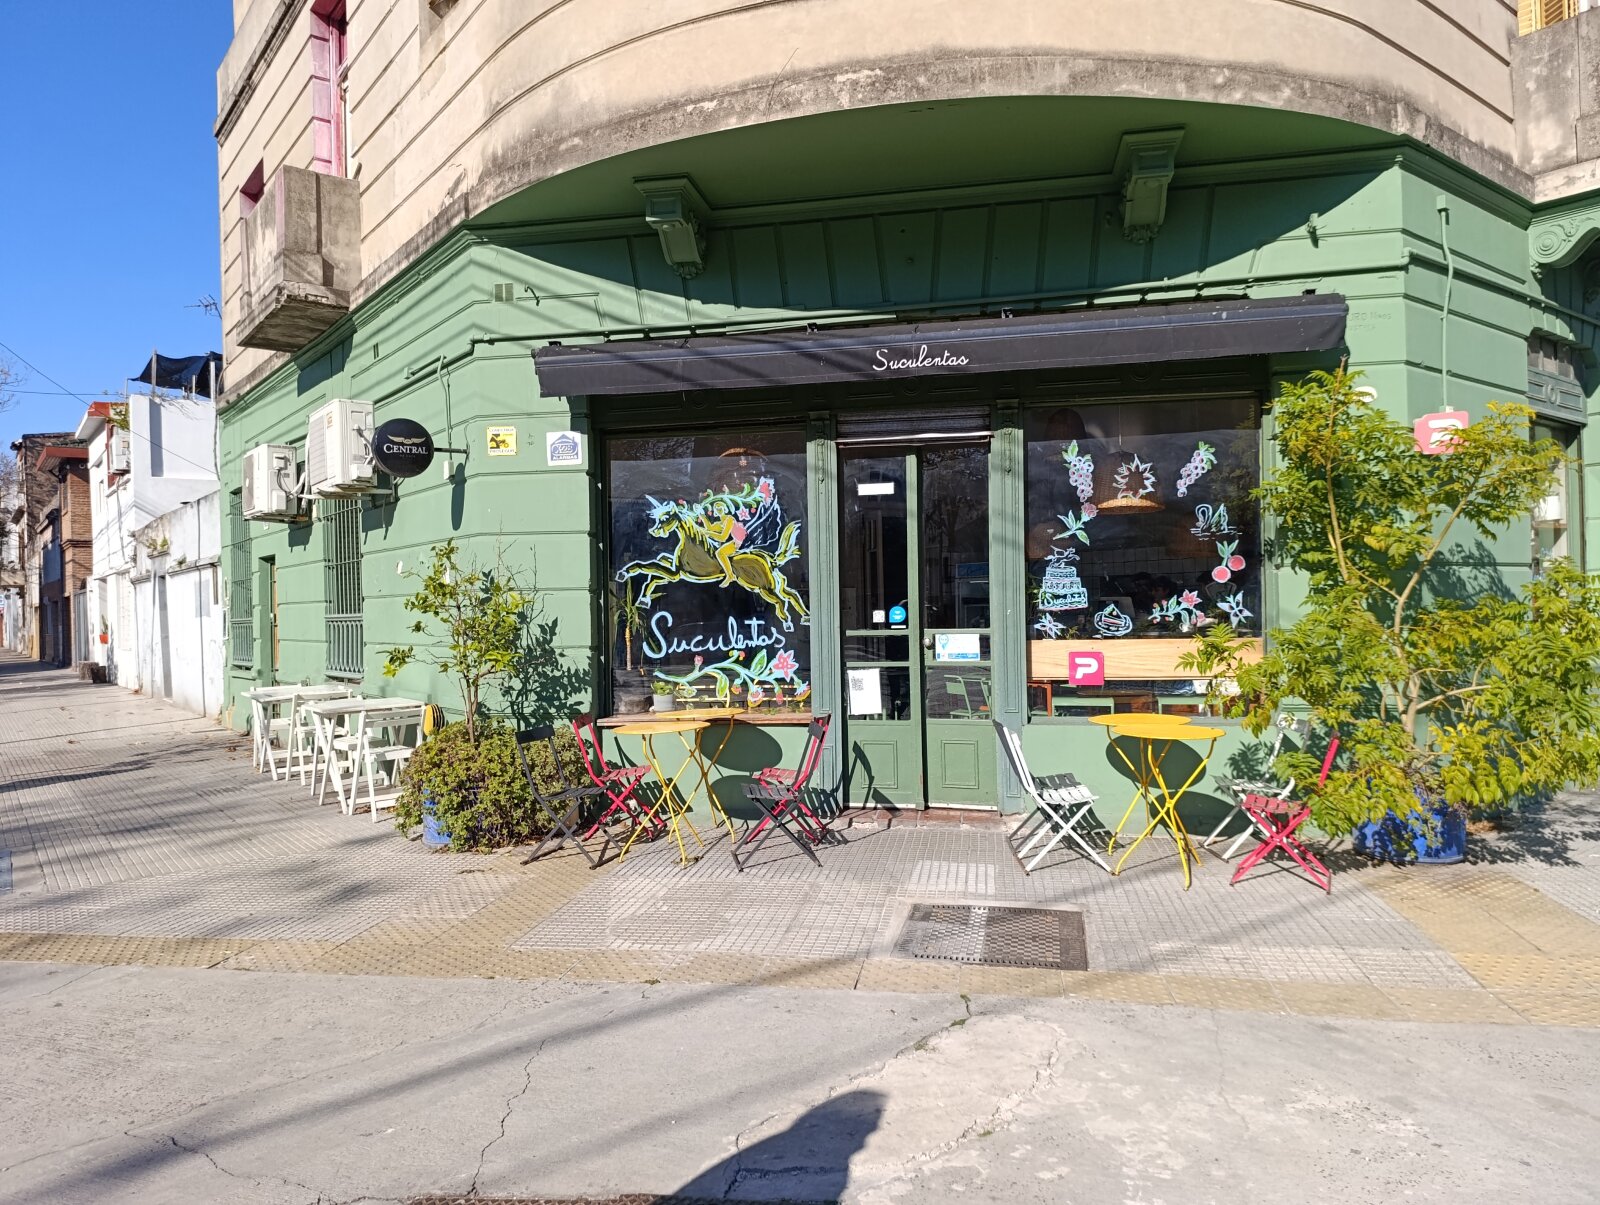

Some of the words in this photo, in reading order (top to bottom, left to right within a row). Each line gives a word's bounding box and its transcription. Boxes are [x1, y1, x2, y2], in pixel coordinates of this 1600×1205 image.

[872, 344, 970, 371] Suculentas
[383, 443, 429, 455] CENTRAL
[642, 611, 786, 659] Suculentas
[1074, 657, 1099, 679] P
